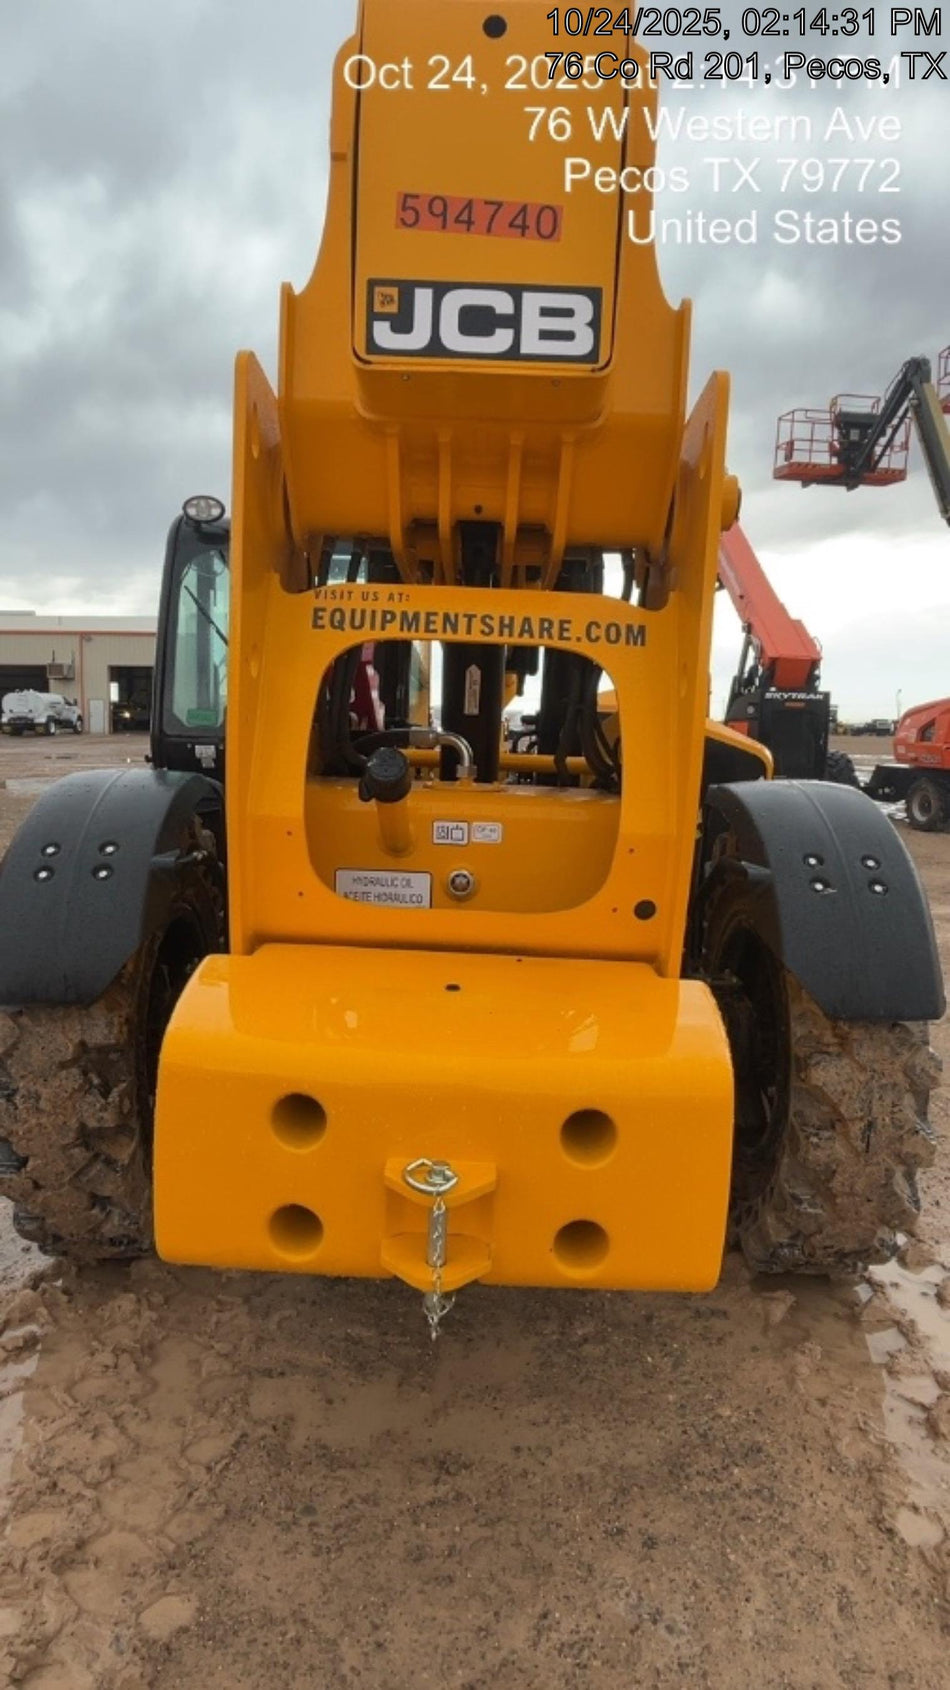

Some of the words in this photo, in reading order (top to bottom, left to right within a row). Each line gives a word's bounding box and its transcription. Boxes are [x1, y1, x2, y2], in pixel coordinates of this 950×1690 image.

[399, 193, 559, 240] 594740
[373, 287, 595, 356] JCB
[314, 589, 354, 601] VISIT
[361, 591, 379, 602] US
[388, 592, 410, 603] AT:
[311, 606, 647, 647] EQUIPMENTSHARE.COM
[352, 876, 399, 889] HYDRAULIC
